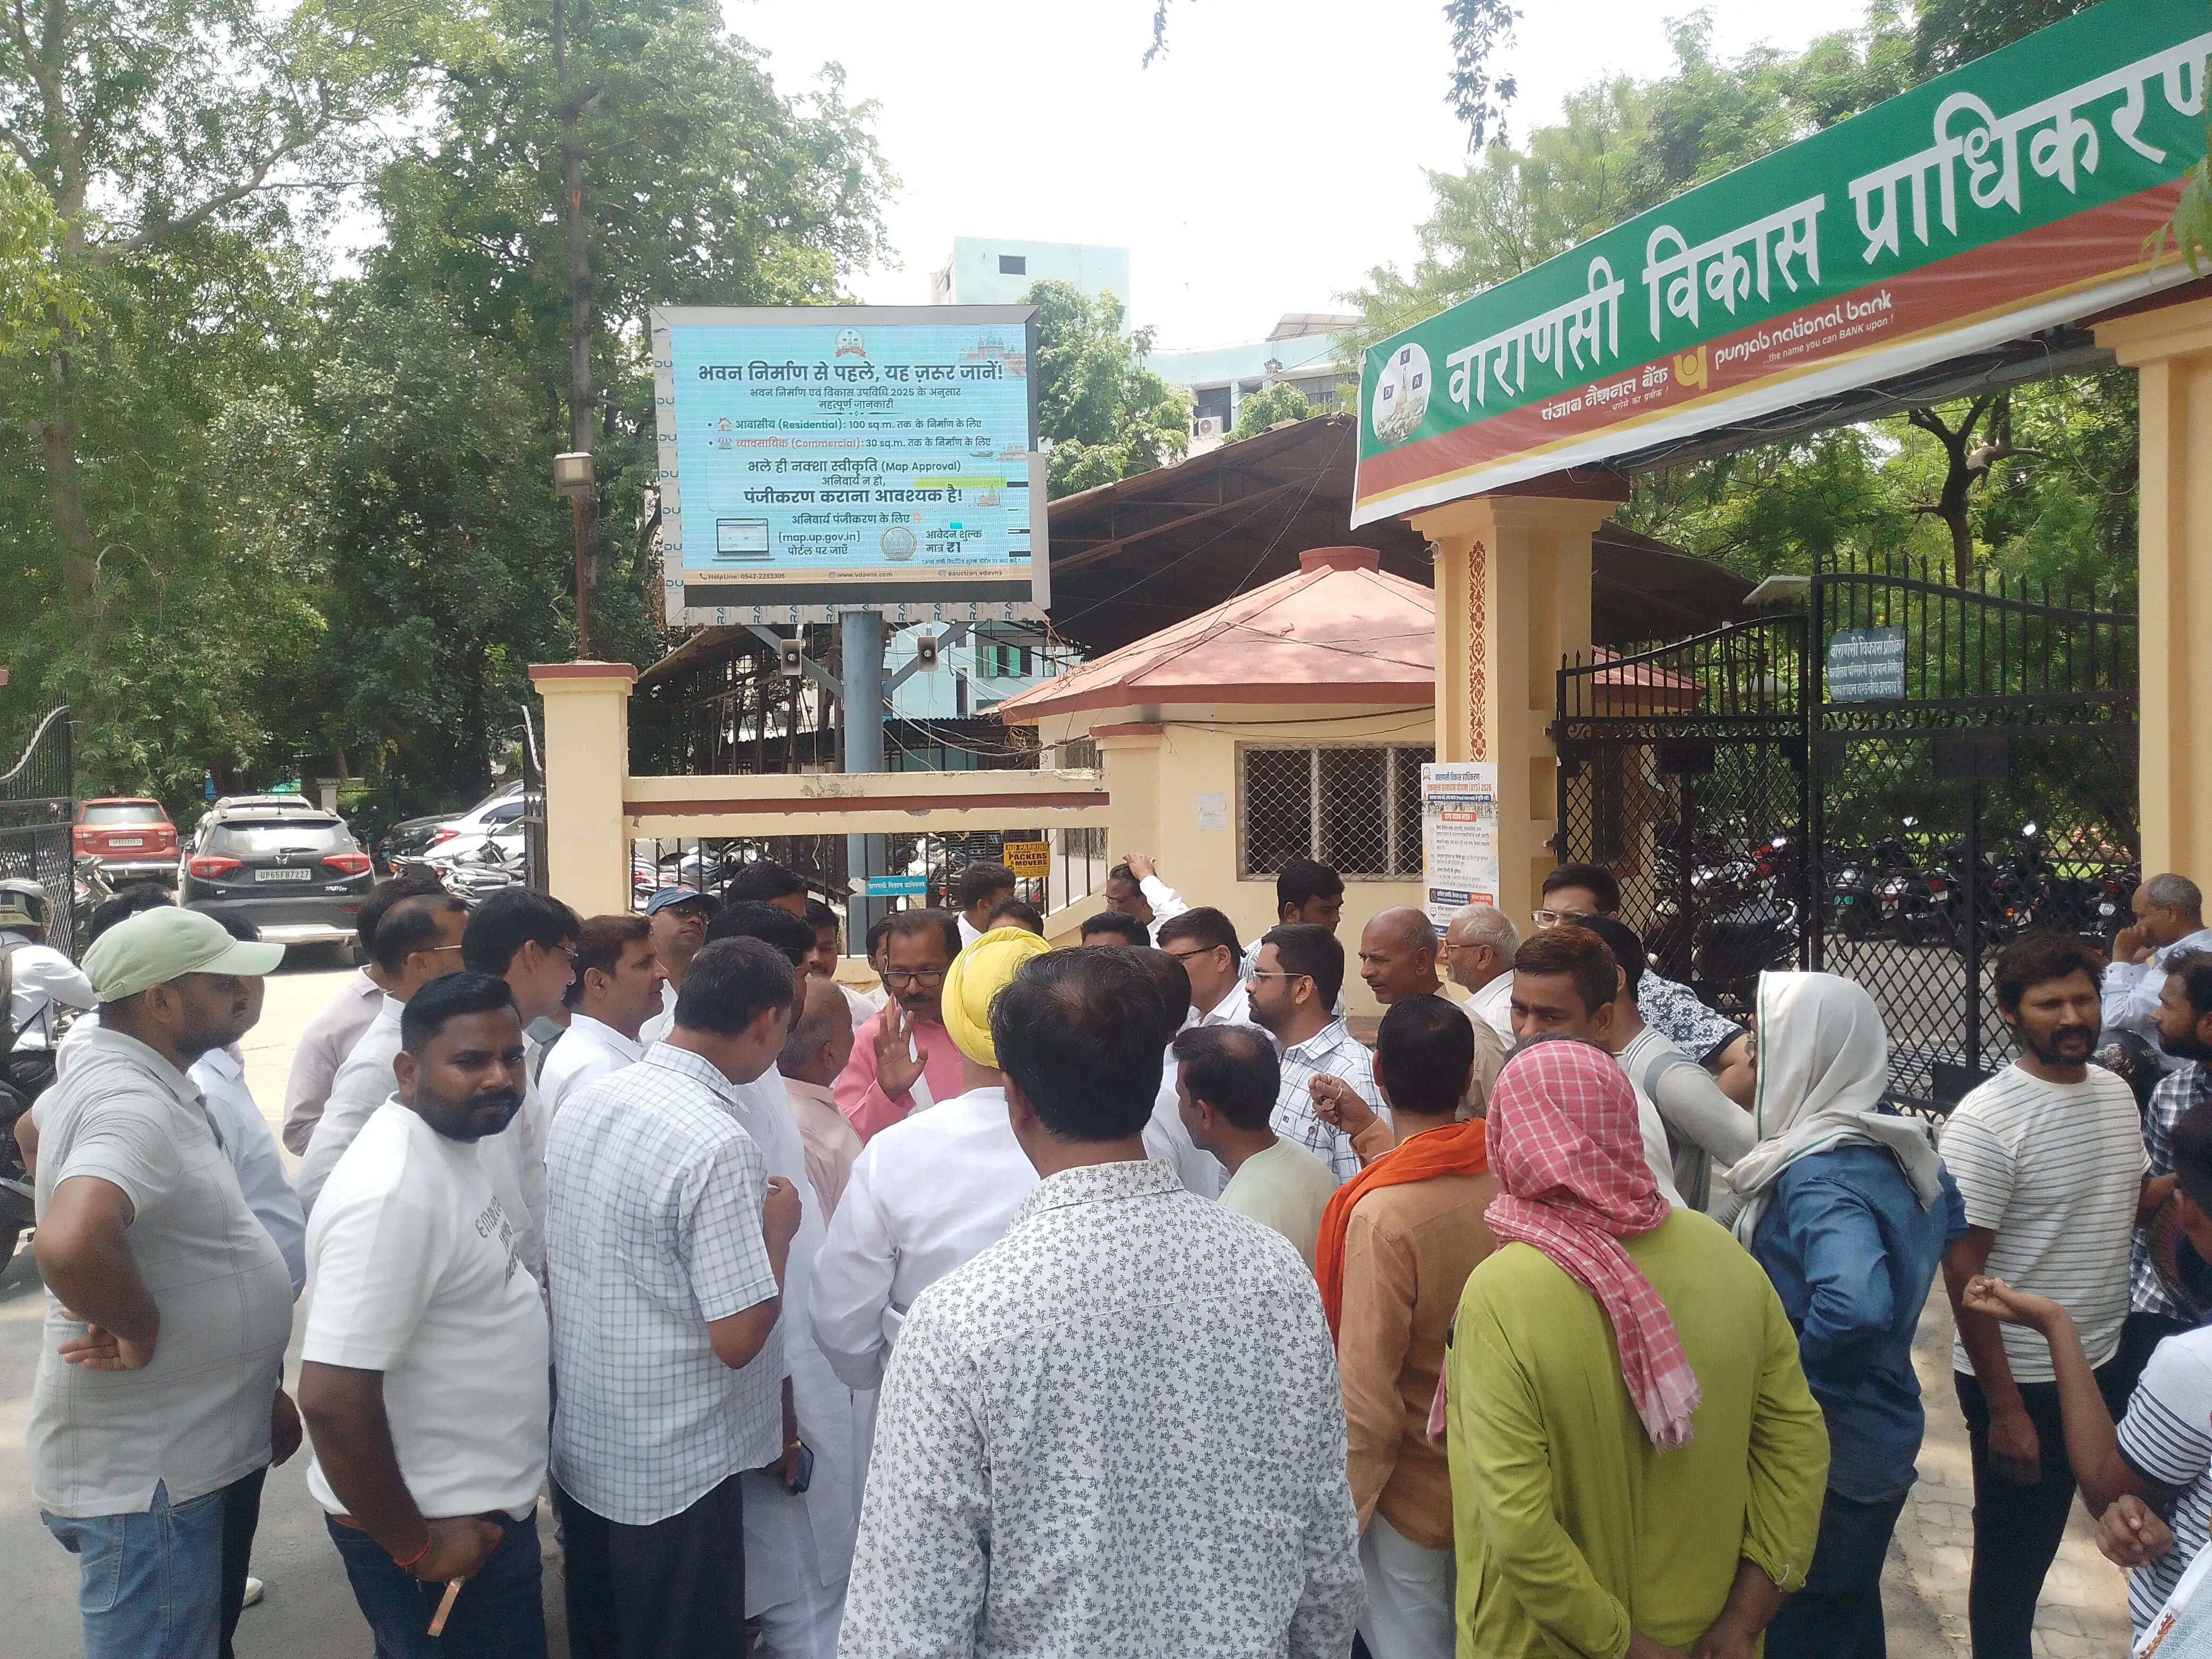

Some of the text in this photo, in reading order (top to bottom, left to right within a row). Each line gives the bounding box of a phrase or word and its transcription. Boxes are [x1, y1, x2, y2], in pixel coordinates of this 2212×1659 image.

[1446, 256, 1624, 414] वाराणसी
[1643, 225, 1824, 343] विकास
[1715, 289, 1892, 371] punjab national bank
[1783, 346, 1804, 358] name
[1806, 339, 1820, 354] you
[1822, 334, 1838, 345] can
[1839, 324, 1864, 340] BANK
[1866, 318, 1888, 335] upon
[1402, 352, 1408, 362] V
[699, 361, 1002, 383] भवन निर्माण से पहले, यह ज़रूर जानें!
[750, 388, 773, 397] भवन
[776, 387, 806, 397] निर्माण
[809, 387, 821, 397] एवं
[824, 387, 853, 397] विकास
[857, 386, 888, 396] उपविधि
[917, 386, 927, 396] के
[930, 388, 961, 398] अनुसार
[1541, 402, 1582, 421] पंजाब
[1642, 365, 1669, 388] बैंक
[1631, 396, 1641, 405] का
[1644, 388, 1663, 401] प्रतीक
[853, 398, 893, 408] जानकारी
[735, 418, 775, 429] आवासीय
[778, 418, 846, 431] (Residential):
[868, 421, 894, 431] sq.m.
[915, 418, 924, 428] के
[927, 418, 953, 428] निर्माण
[956, 418, 964, 428] के
[967, 417, 983, 428] लिए
[736, 437, 788, 447] व्यावसायिक
[792, 437, 864, 449] (Commercial):
[879, 440, 905, 449] sq.m.
[925, 437, 932, 447] के
[935, 436, 962, 447] निर्माण
[965, 436, 973, 447] के
[975, 435, 991, 447] लिए
[748, 457, 961, 476] भले ही नक्शा स्वीकृति (Map Approval)
[822, 474, 886, 487] अनिवार्य न हो,
[744, 483, 962, 503] पंजीकरण कराना आवश्यक है!
[792, 512, 910, 524] अनिवार्य पंजीकरण के लिए
[778, 532, 860, 543] [map.up.gov.in]
[926, 529, 983, 542] आवेदन शुल्क
[788, 544, 812, 555] पोर्टल
[926, 544, 943, 553] मात्र
[1831, 636, 1858, 659] वाराणसी
[1858, 635, 1883, 656] विकास
[1469, 783, 1480, 792] (OTS)
